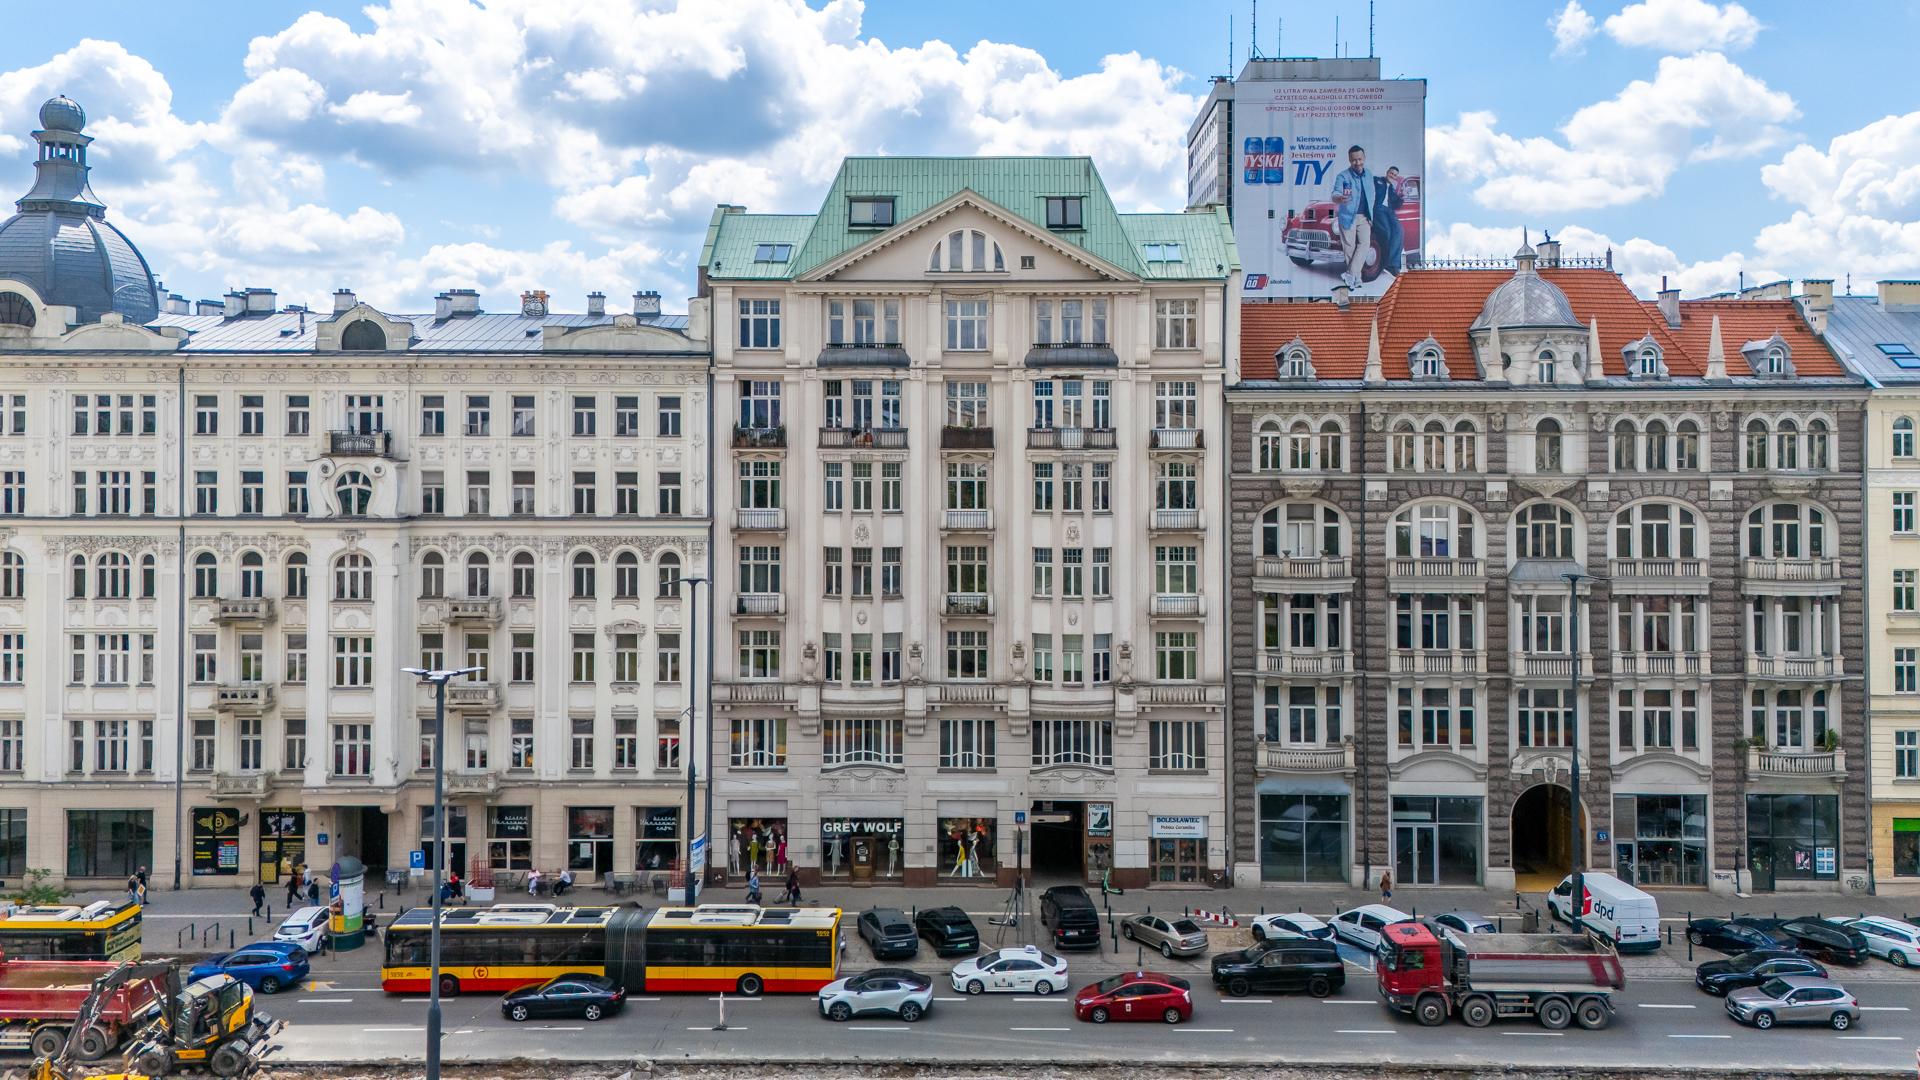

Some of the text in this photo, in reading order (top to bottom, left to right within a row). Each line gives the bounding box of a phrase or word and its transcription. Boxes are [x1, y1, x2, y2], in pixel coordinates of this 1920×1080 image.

[1292, 160, 1333, 185] TY
[822, 822, 902, 833] GREY WOLF
[413, 852, 422, 863] P
[332, 883, 338, 896] P
[1594, 900, 1614, 920] dpd
